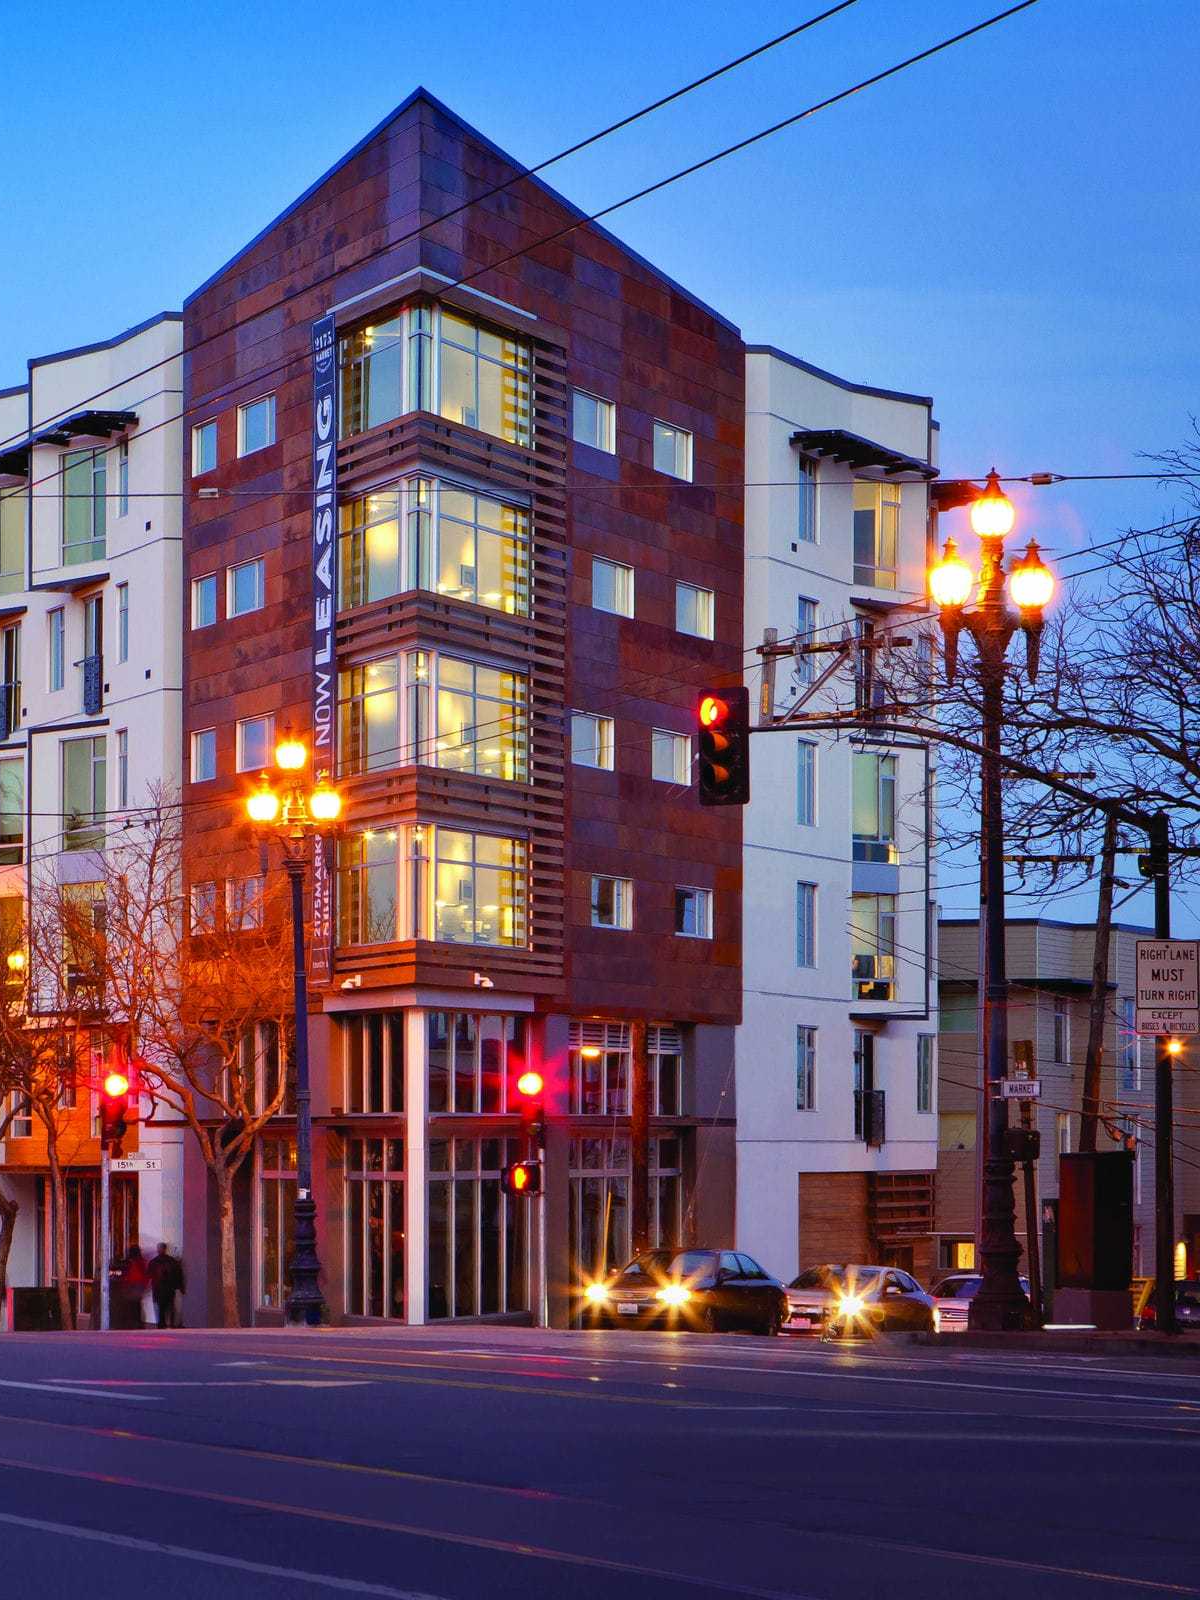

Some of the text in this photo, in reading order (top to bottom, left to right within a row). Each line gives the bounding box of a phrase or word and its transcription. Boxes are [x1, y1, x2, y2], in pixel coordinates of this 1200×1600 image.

[315, 394, 333, 746] NOW LEASING
[1140, 949, 1195, 960] RIGHT LANE
[1151, 968, 1185, 981] MUST
[1139, 989, 1196, 1000] TURN RIGHT
[1151, 1011, 1183, 1020] EXCEPT
[1008, 1083, 1035, 1094] MARKET
[146, 1160, 156, 1169] St
